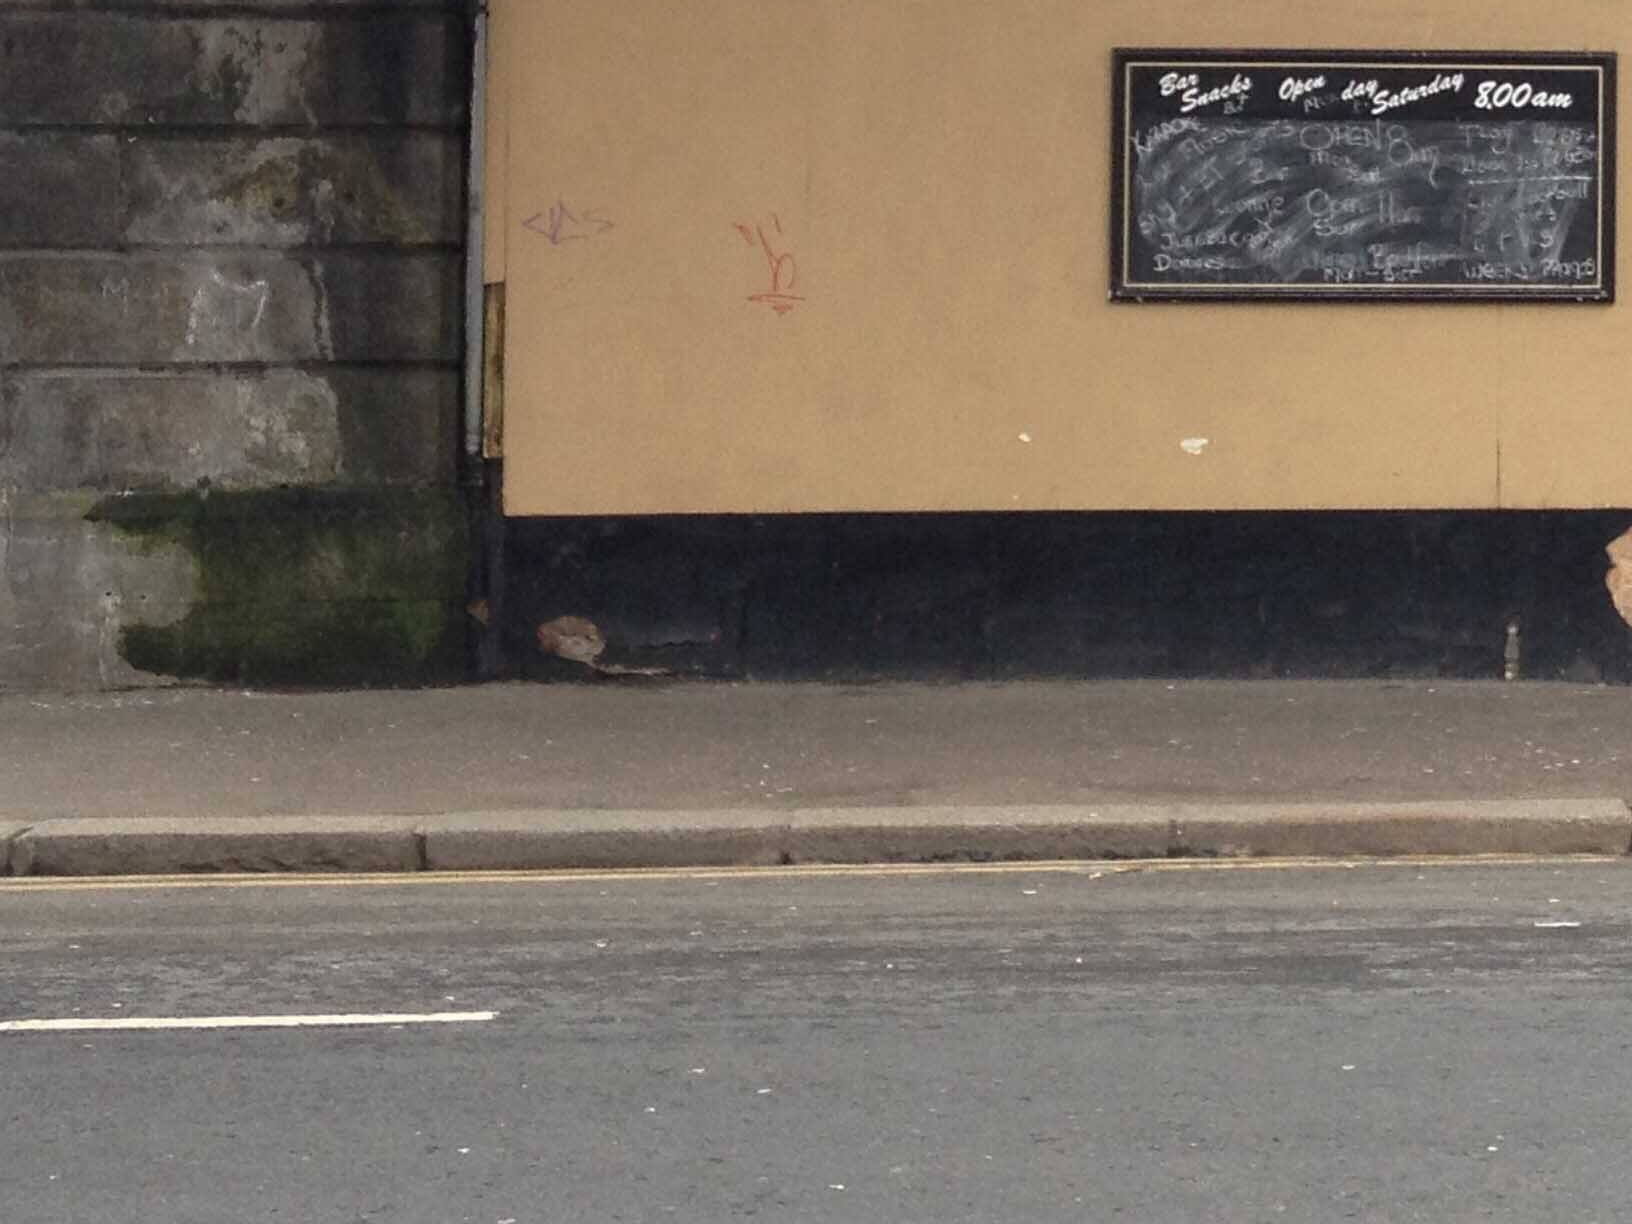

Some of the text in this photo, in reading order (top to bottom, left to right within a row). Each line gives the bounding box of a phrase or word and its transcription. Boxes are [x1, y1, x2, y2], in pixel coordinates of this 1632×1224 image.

[1159, 72, 1199, 96] Bar
[1180, 74, 1252, 112] Snacks
[1278, 76, 1326, 102] Open
[1341, 80, 1379, 100] day
[1371, 73, 1464, 115] Saturday
